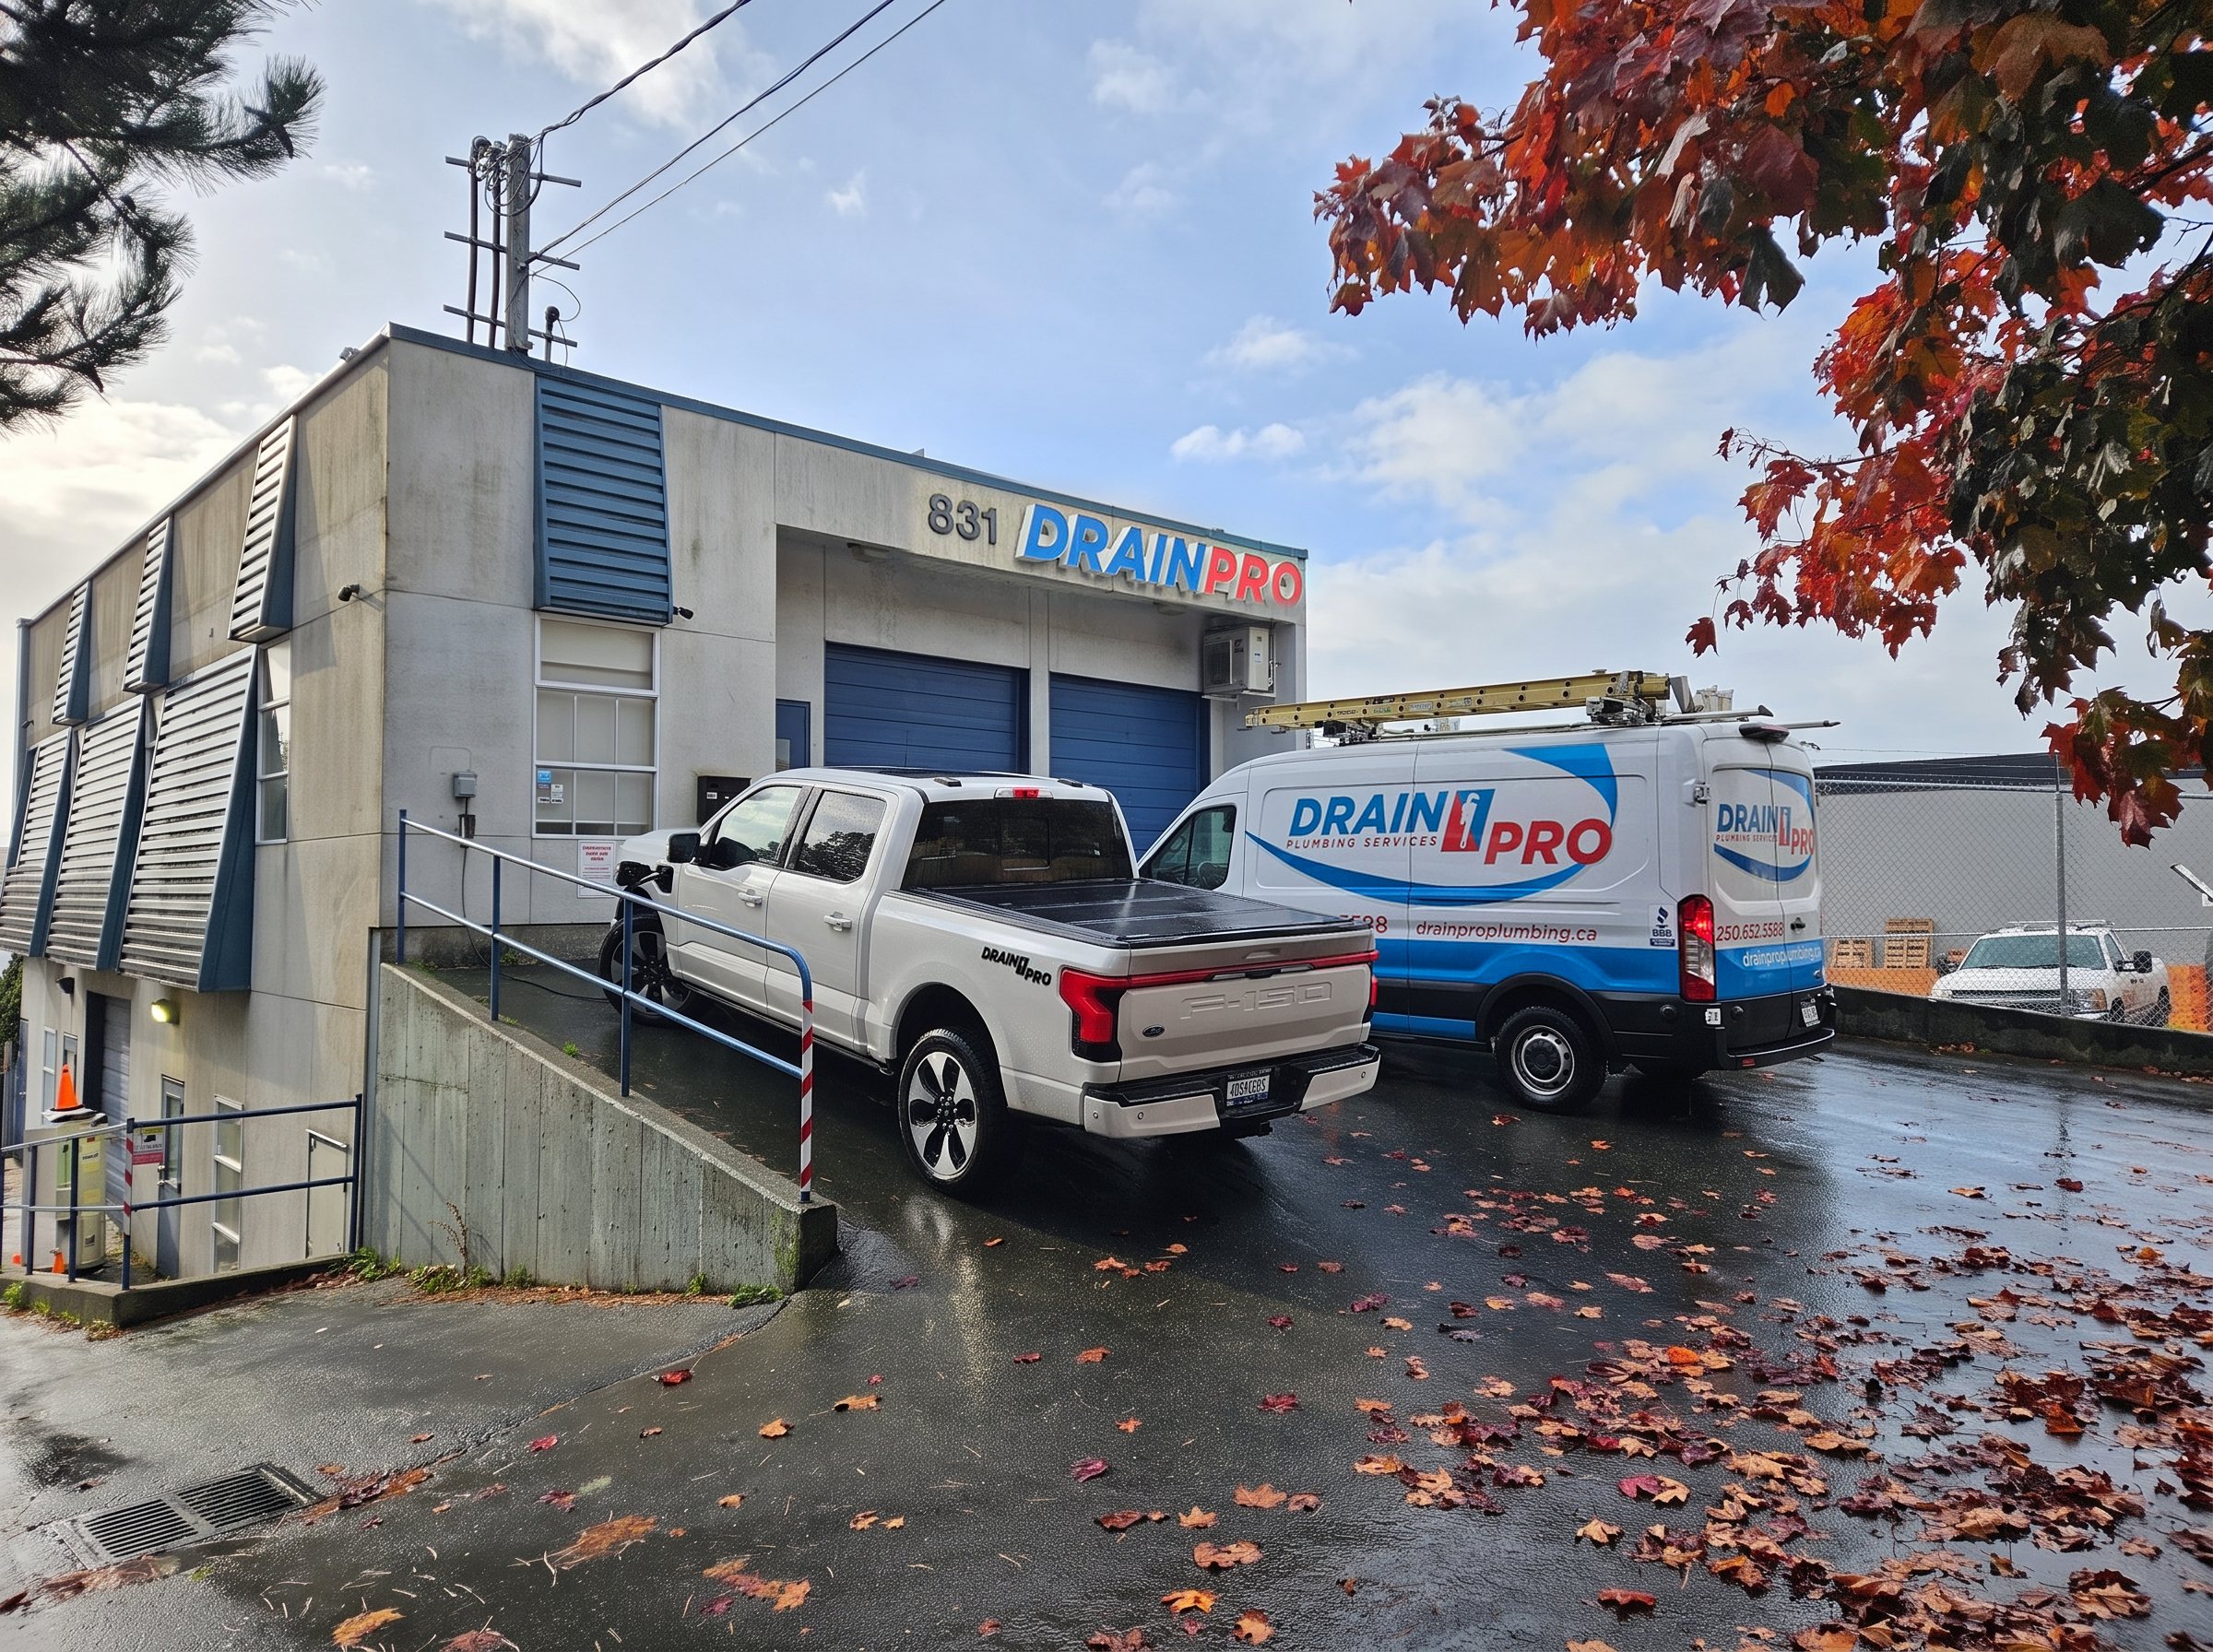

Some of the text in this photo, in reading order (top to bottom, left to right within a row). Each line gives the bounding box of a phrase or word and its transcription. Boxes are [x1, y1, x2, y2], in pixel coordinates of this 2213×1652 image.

[928, 492, 998, 546] 831
[1288, 791, 1613, 865] DRAIN PRO
[1717, 803, 1778, 832] DRAIN
[1286, 835, 1438, 849] PLUMBING SERVICES
[1416, 921, 1597, 943] drainproplumbing.ca
[1652, 928, 1673, 937] BBB
[1716, 922, 1785, 941] 250.652.5588
[981, 946, 1052, 986] DRAIN PRO
[1180, 981, 1332, 1020] F-150
